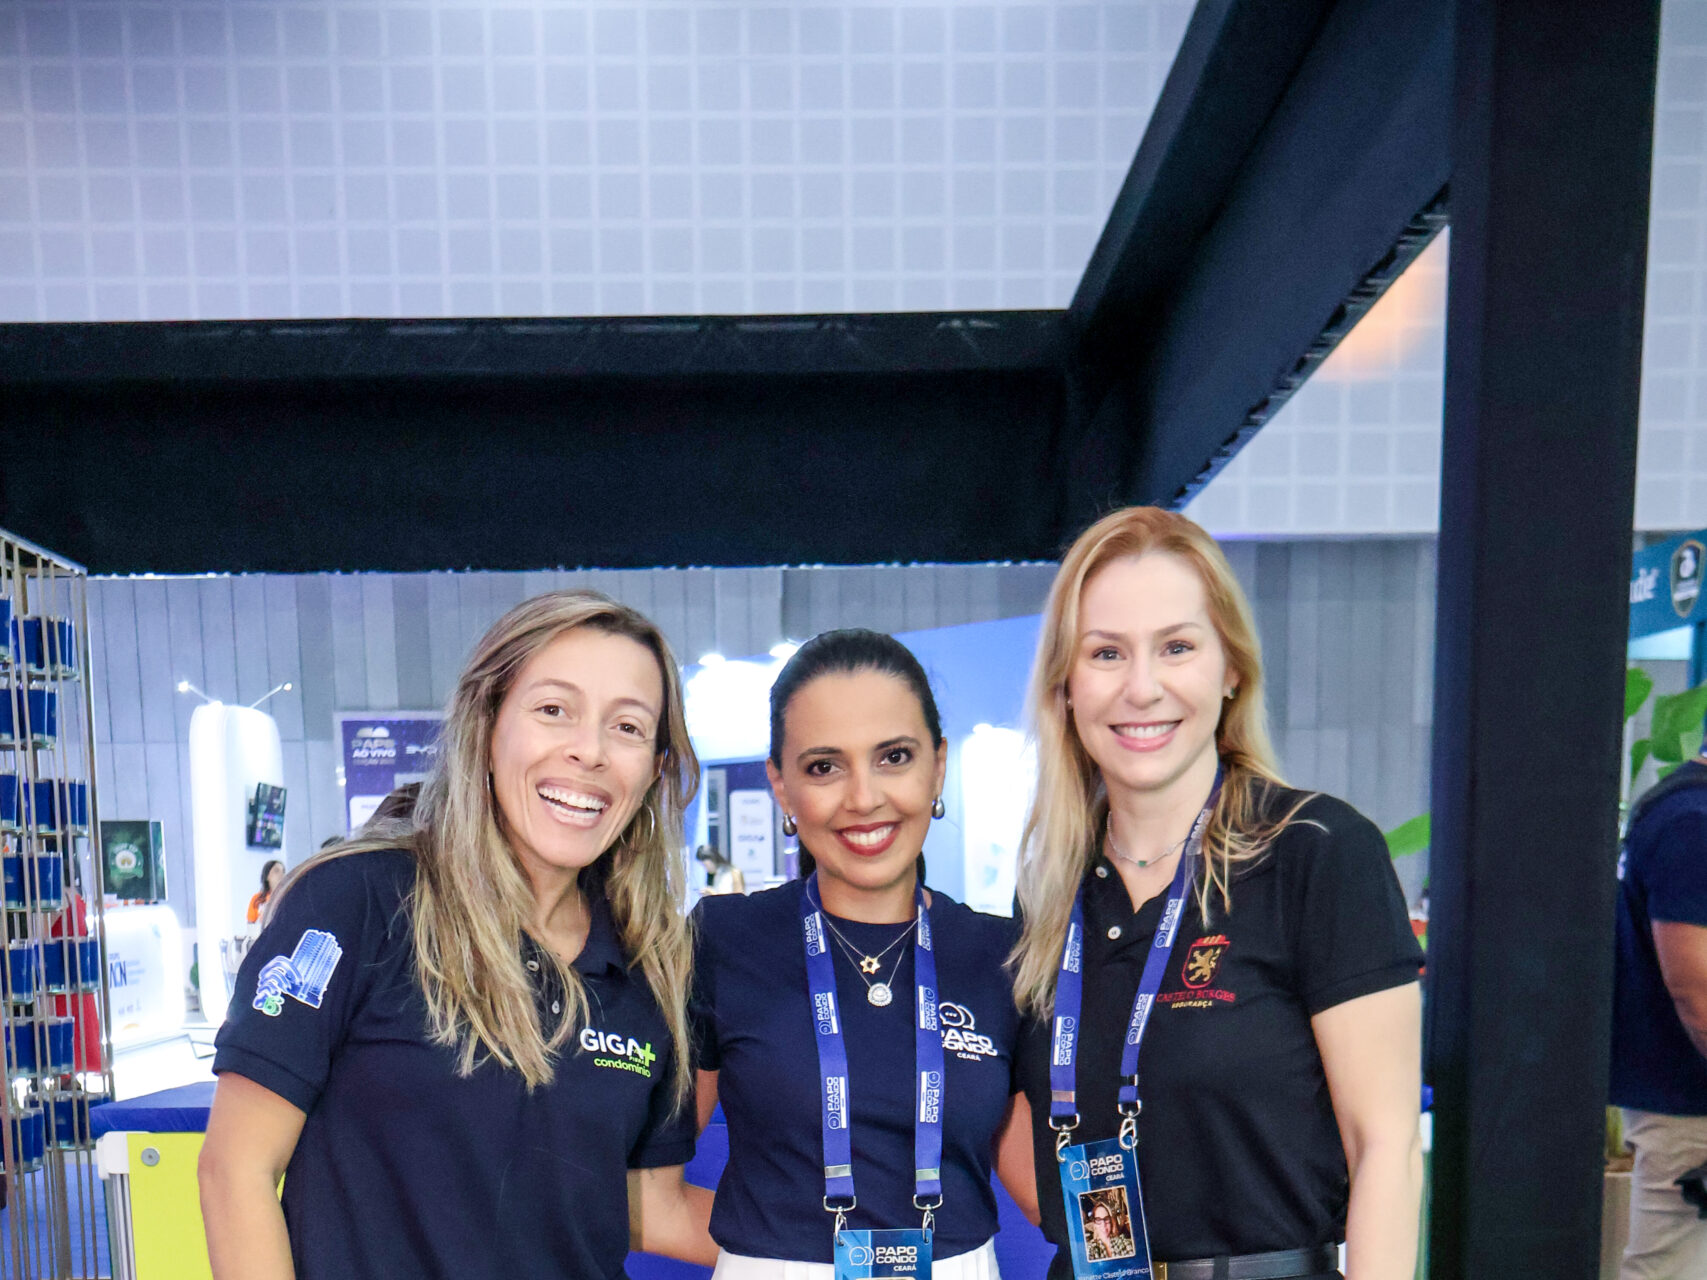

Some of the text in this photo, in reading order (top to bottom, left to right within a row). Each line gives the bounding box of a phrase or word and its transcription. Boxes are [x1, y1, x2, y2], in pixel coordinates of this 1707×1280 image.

[370, 748, 397, 758] VIVO
[804, 916, 812, 943] PAPO
[814, 993, 824, 1021] PAPO
[1196, 989, 1236, 1003] BORGES
[929, 1003, 938, 1031] PAPO
[1131, 993, 1145, 1027] PAPO
[941, 1028, 993, 1050] APO
[1064, 1033, 1074, 1066] PAPO
[826, 1076, 834, 1111] PAPO
[925, 1089, 933, 1123] CONDO
[931, 1089, 940, 1123] PAPO
[1090, 1154, 1123, 1169] PAPO
[1090, 1163, 1125, 1176] CONDO
[875, 1246, 918, 1256] PAPO
[875, 1255, 918, 1264] CONDO
[893, 1264, 917, 1272] CEARÁ
